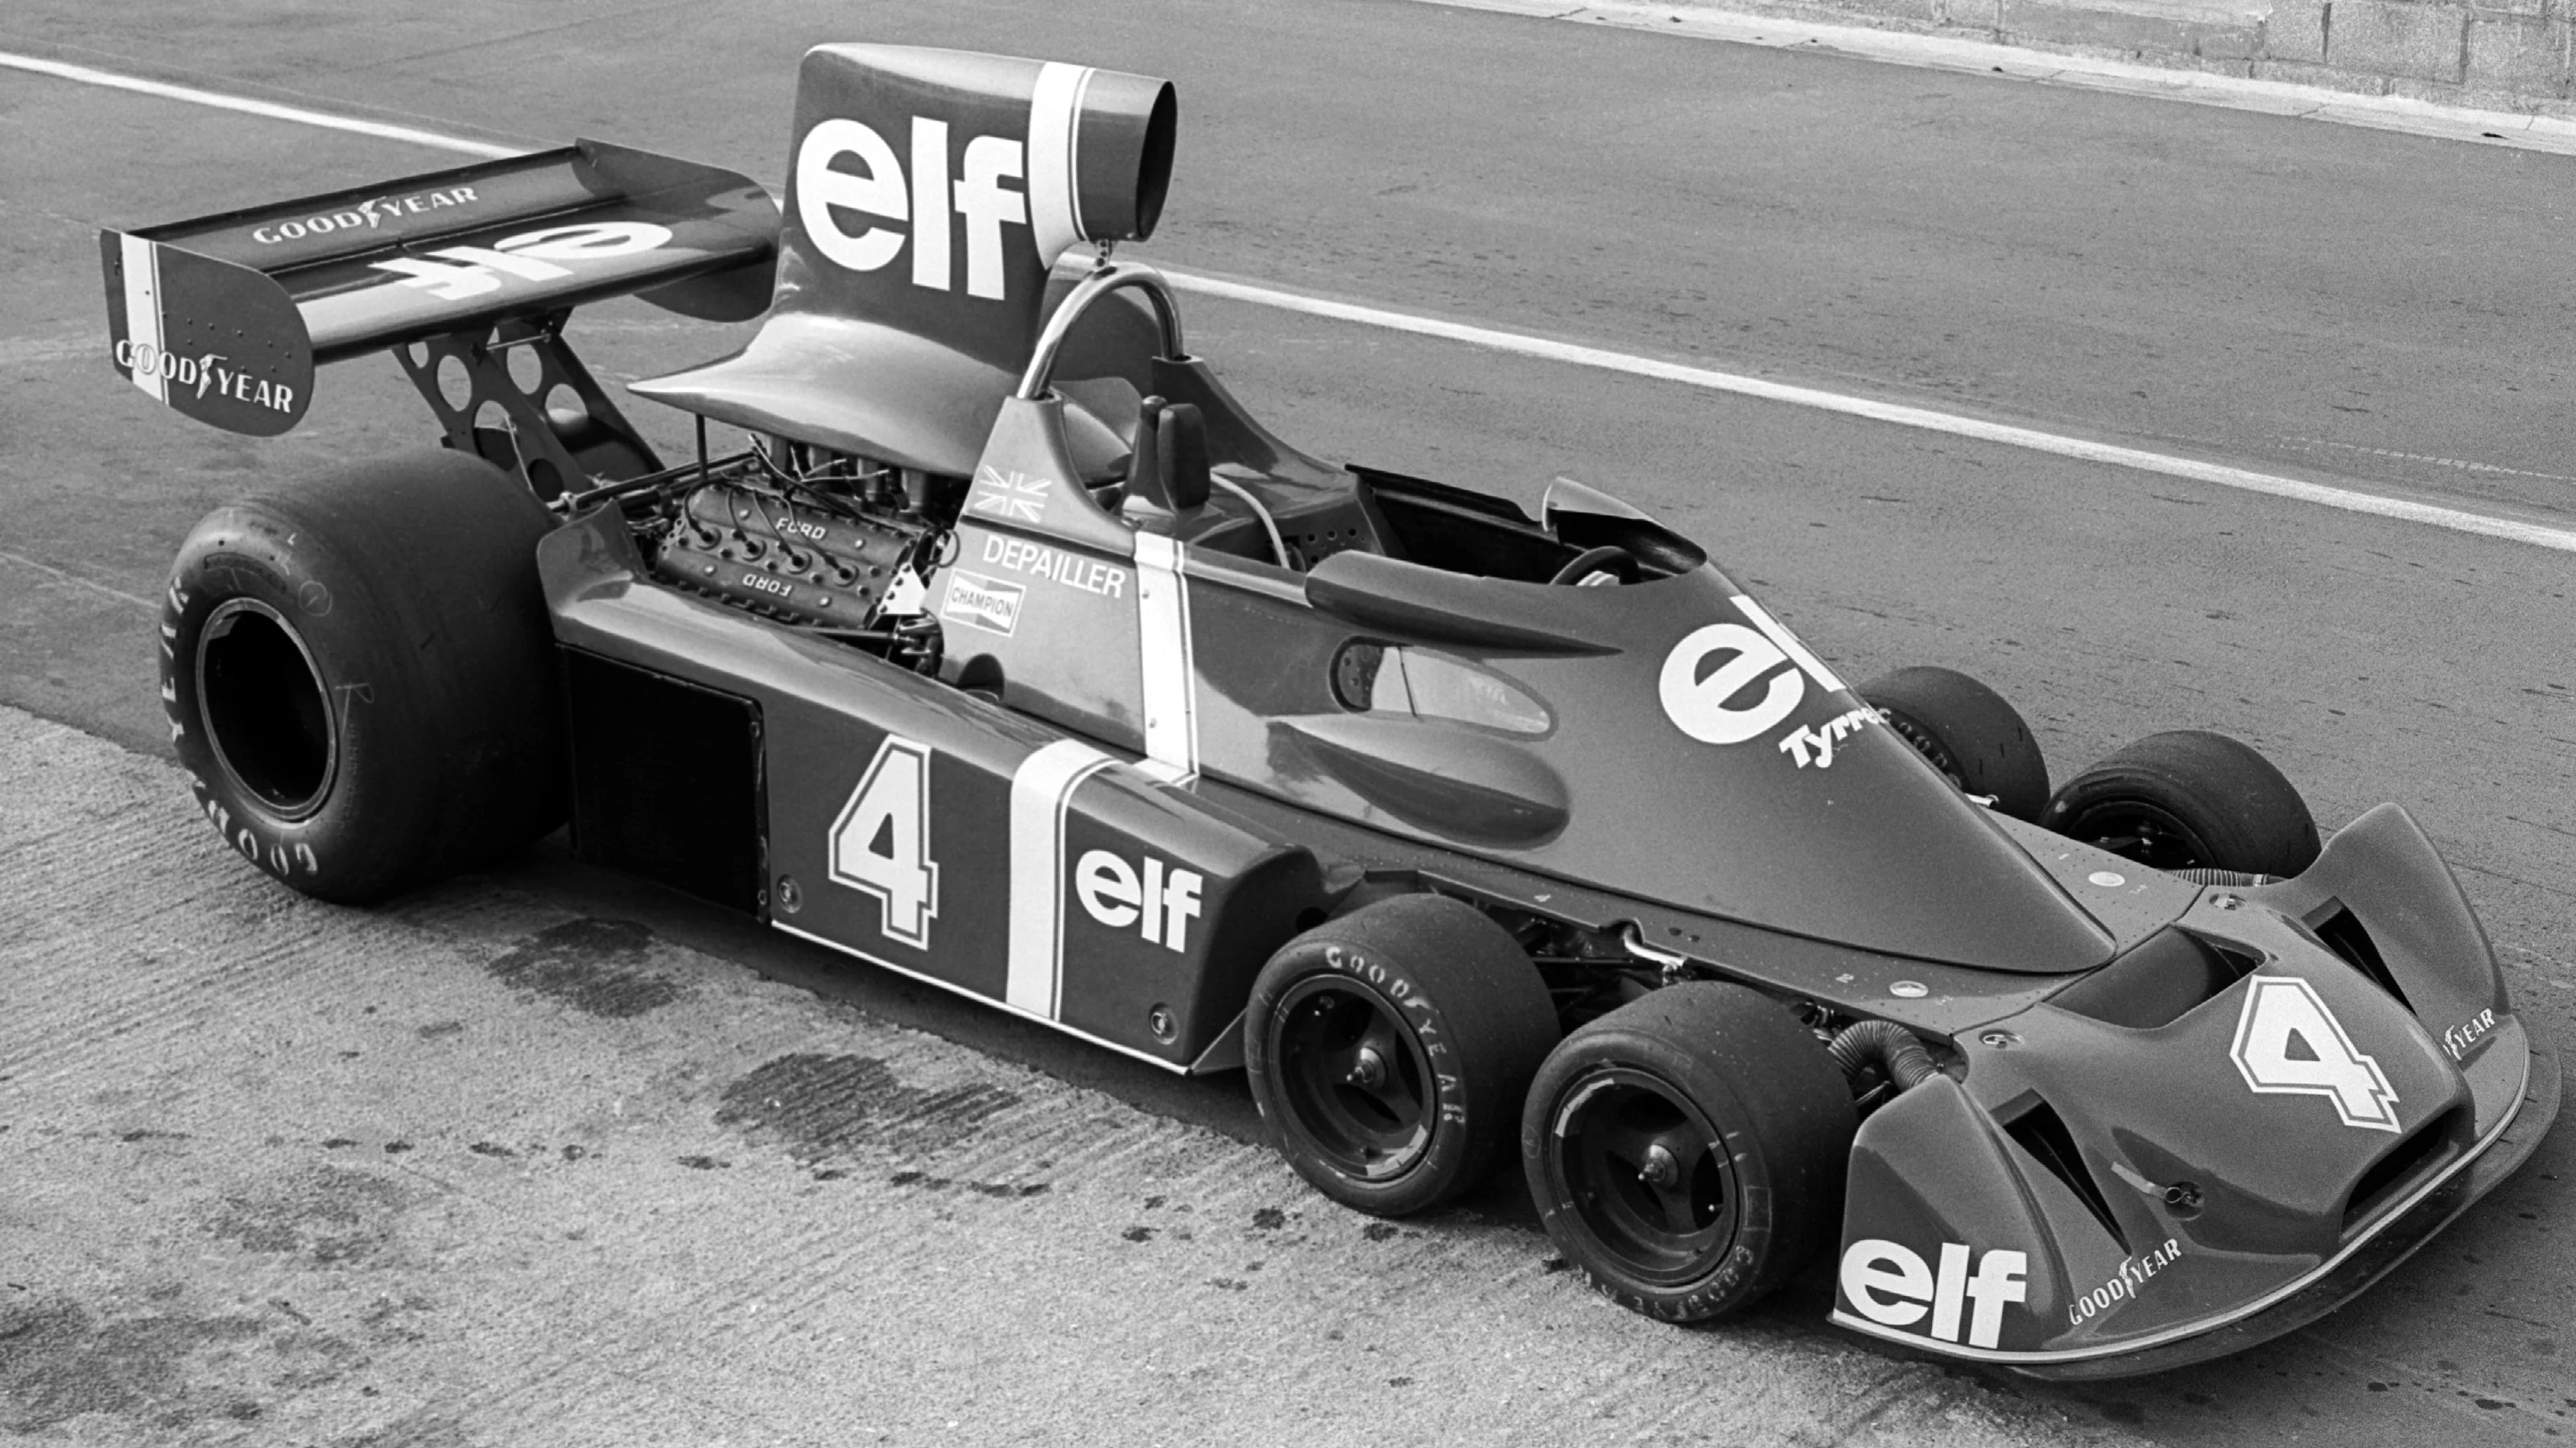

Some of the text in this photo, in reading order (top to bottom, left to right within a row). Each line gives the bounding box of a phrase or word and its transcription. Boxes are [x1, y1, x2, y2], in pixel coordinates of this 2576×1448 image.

[253, 188, 478, 244] GOODYEAR
[797, 116, 1026, 300] elf
[116, 339, 294, 414] GOODYEAR
[743, 574, 792, 597] FORD
[952, 587, 1014, 617] CHAMPION
[983, 535, 1125, 599] DEPAILLER
[828, 733, 939, 951] 4
[1075, 849, 1203, 953] elf
[2230, 975, 2402, 1133] 4
[2442, 1007, 2496, 1061] YEAR
[1840, 1240, 2027, 1350] elf
[2069, 1238, 2182, 1326] GOODYEAR
